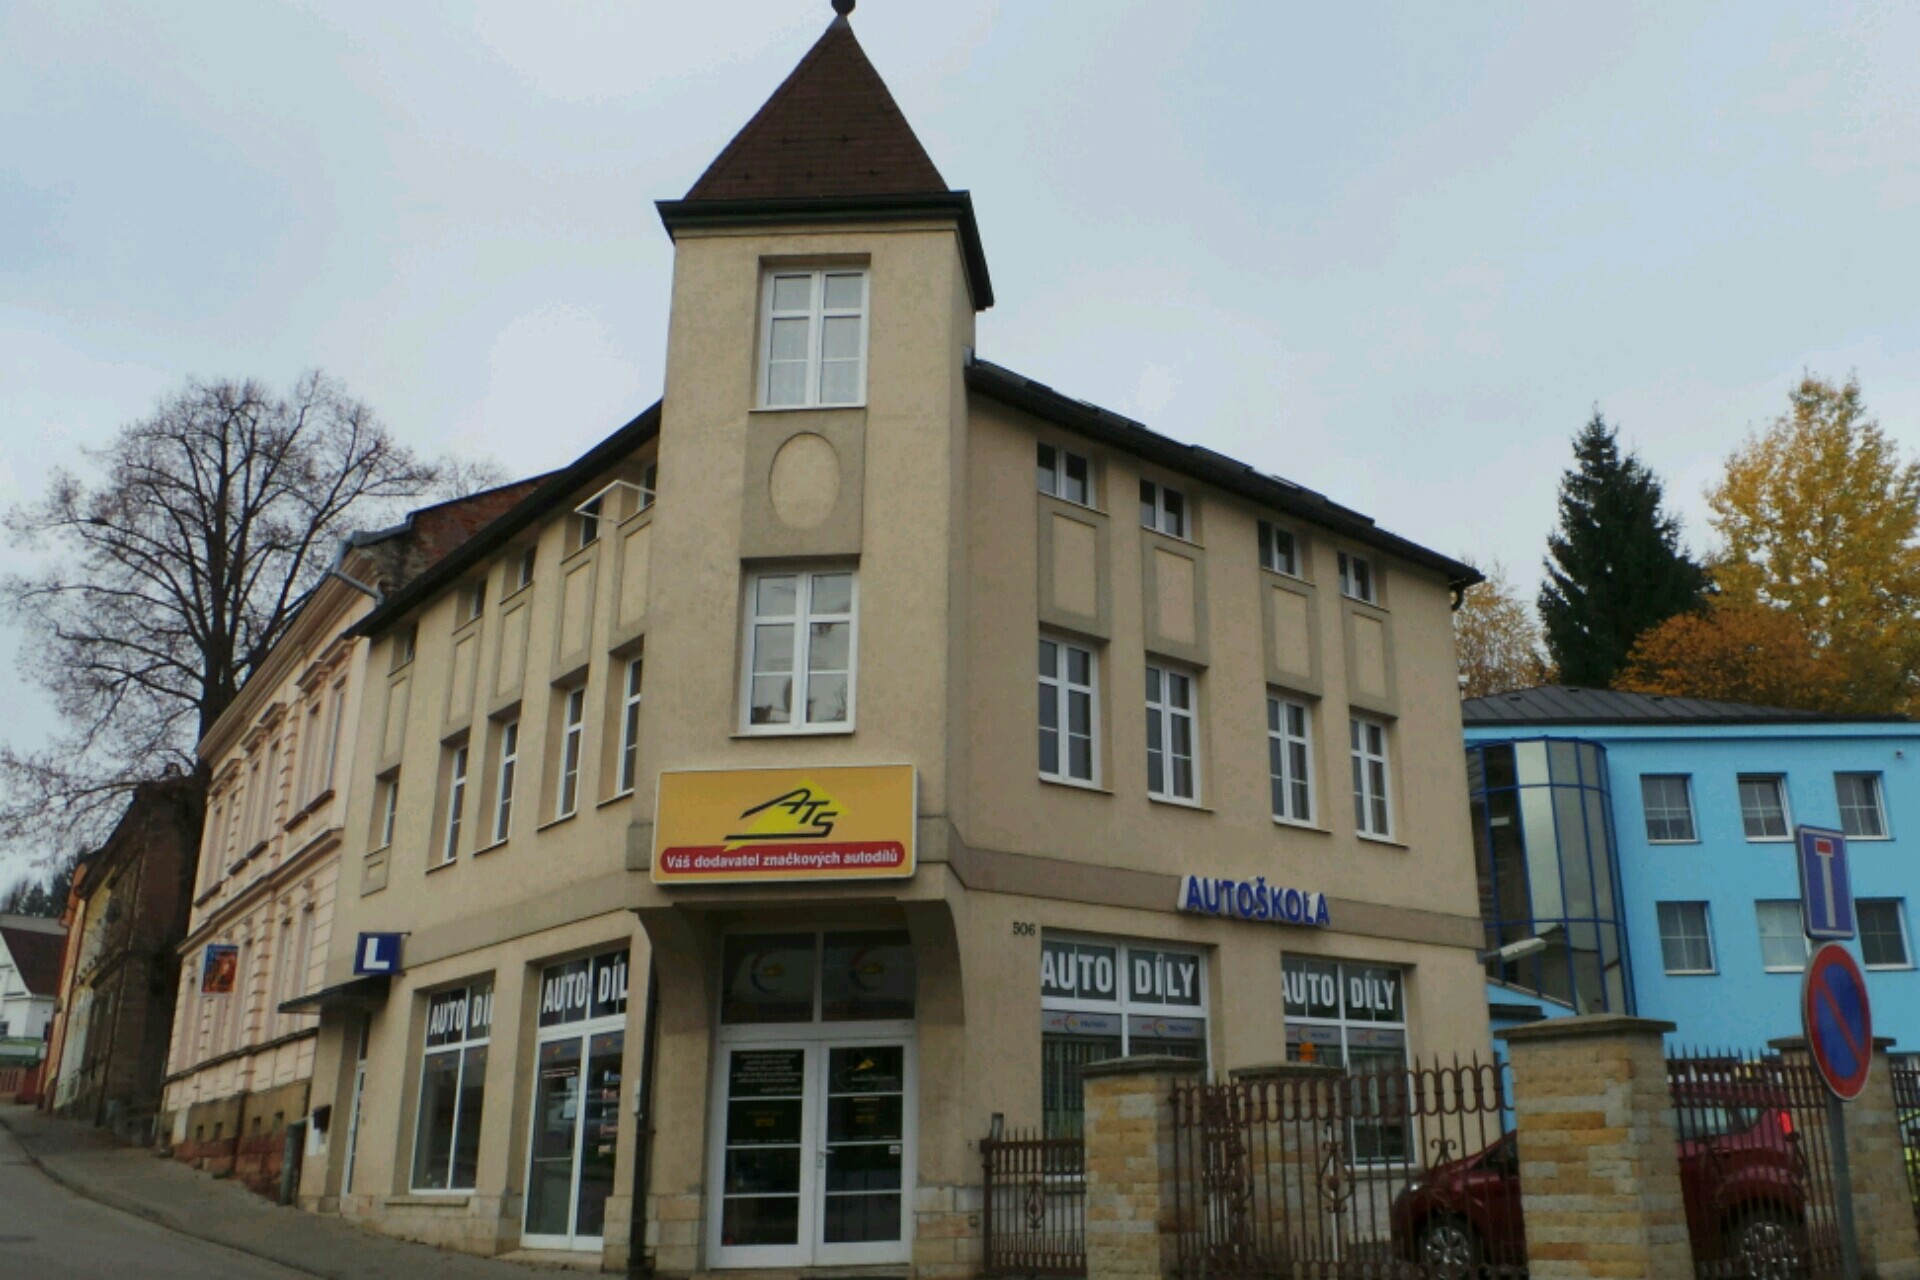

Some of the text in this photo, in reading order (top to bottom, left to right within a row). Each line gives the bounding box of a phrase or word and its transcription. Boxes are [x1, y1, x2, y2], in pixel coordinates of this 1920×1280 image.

[723, 788, 839, 841] ATS
[667, 848, 898, 869] Váš dodavatel značkových autodílů
[1186, 874, 1331, 926] AUTOŠKOLA
[1012, 921, 1036, 937] 506
[363, 937, 390, 971] L
[1041, 951, 1196, 999] AUTO DÍLY
[542, 971, 588, 1015] AUTO
[1282, 969, 1396, 1011] AUTO DÍLY
[430, 998, 466, 1036] AUTO
